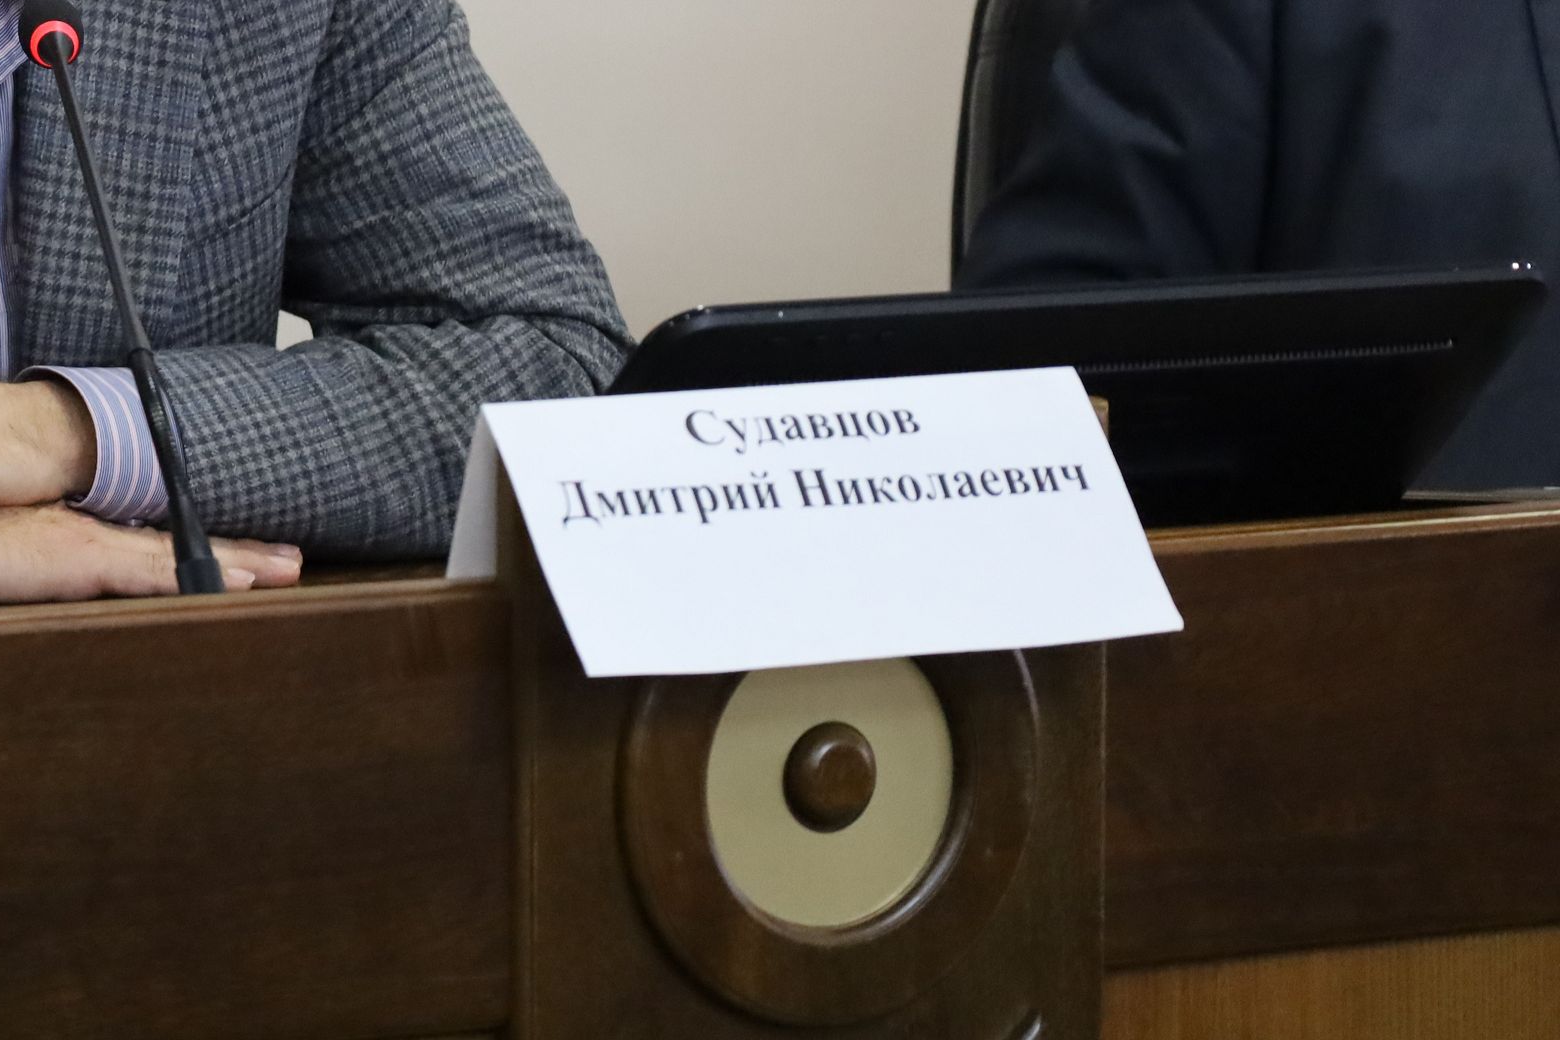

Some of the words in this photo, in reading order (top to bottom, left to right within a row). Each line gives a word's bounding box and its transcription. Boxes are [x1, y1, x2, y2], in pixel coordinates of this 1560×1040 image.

[684, 407, 921, 454] Судавцов
[561, 472, 781, 525] Дмитрий
[796, 462, 1091, 509] Николаевич
